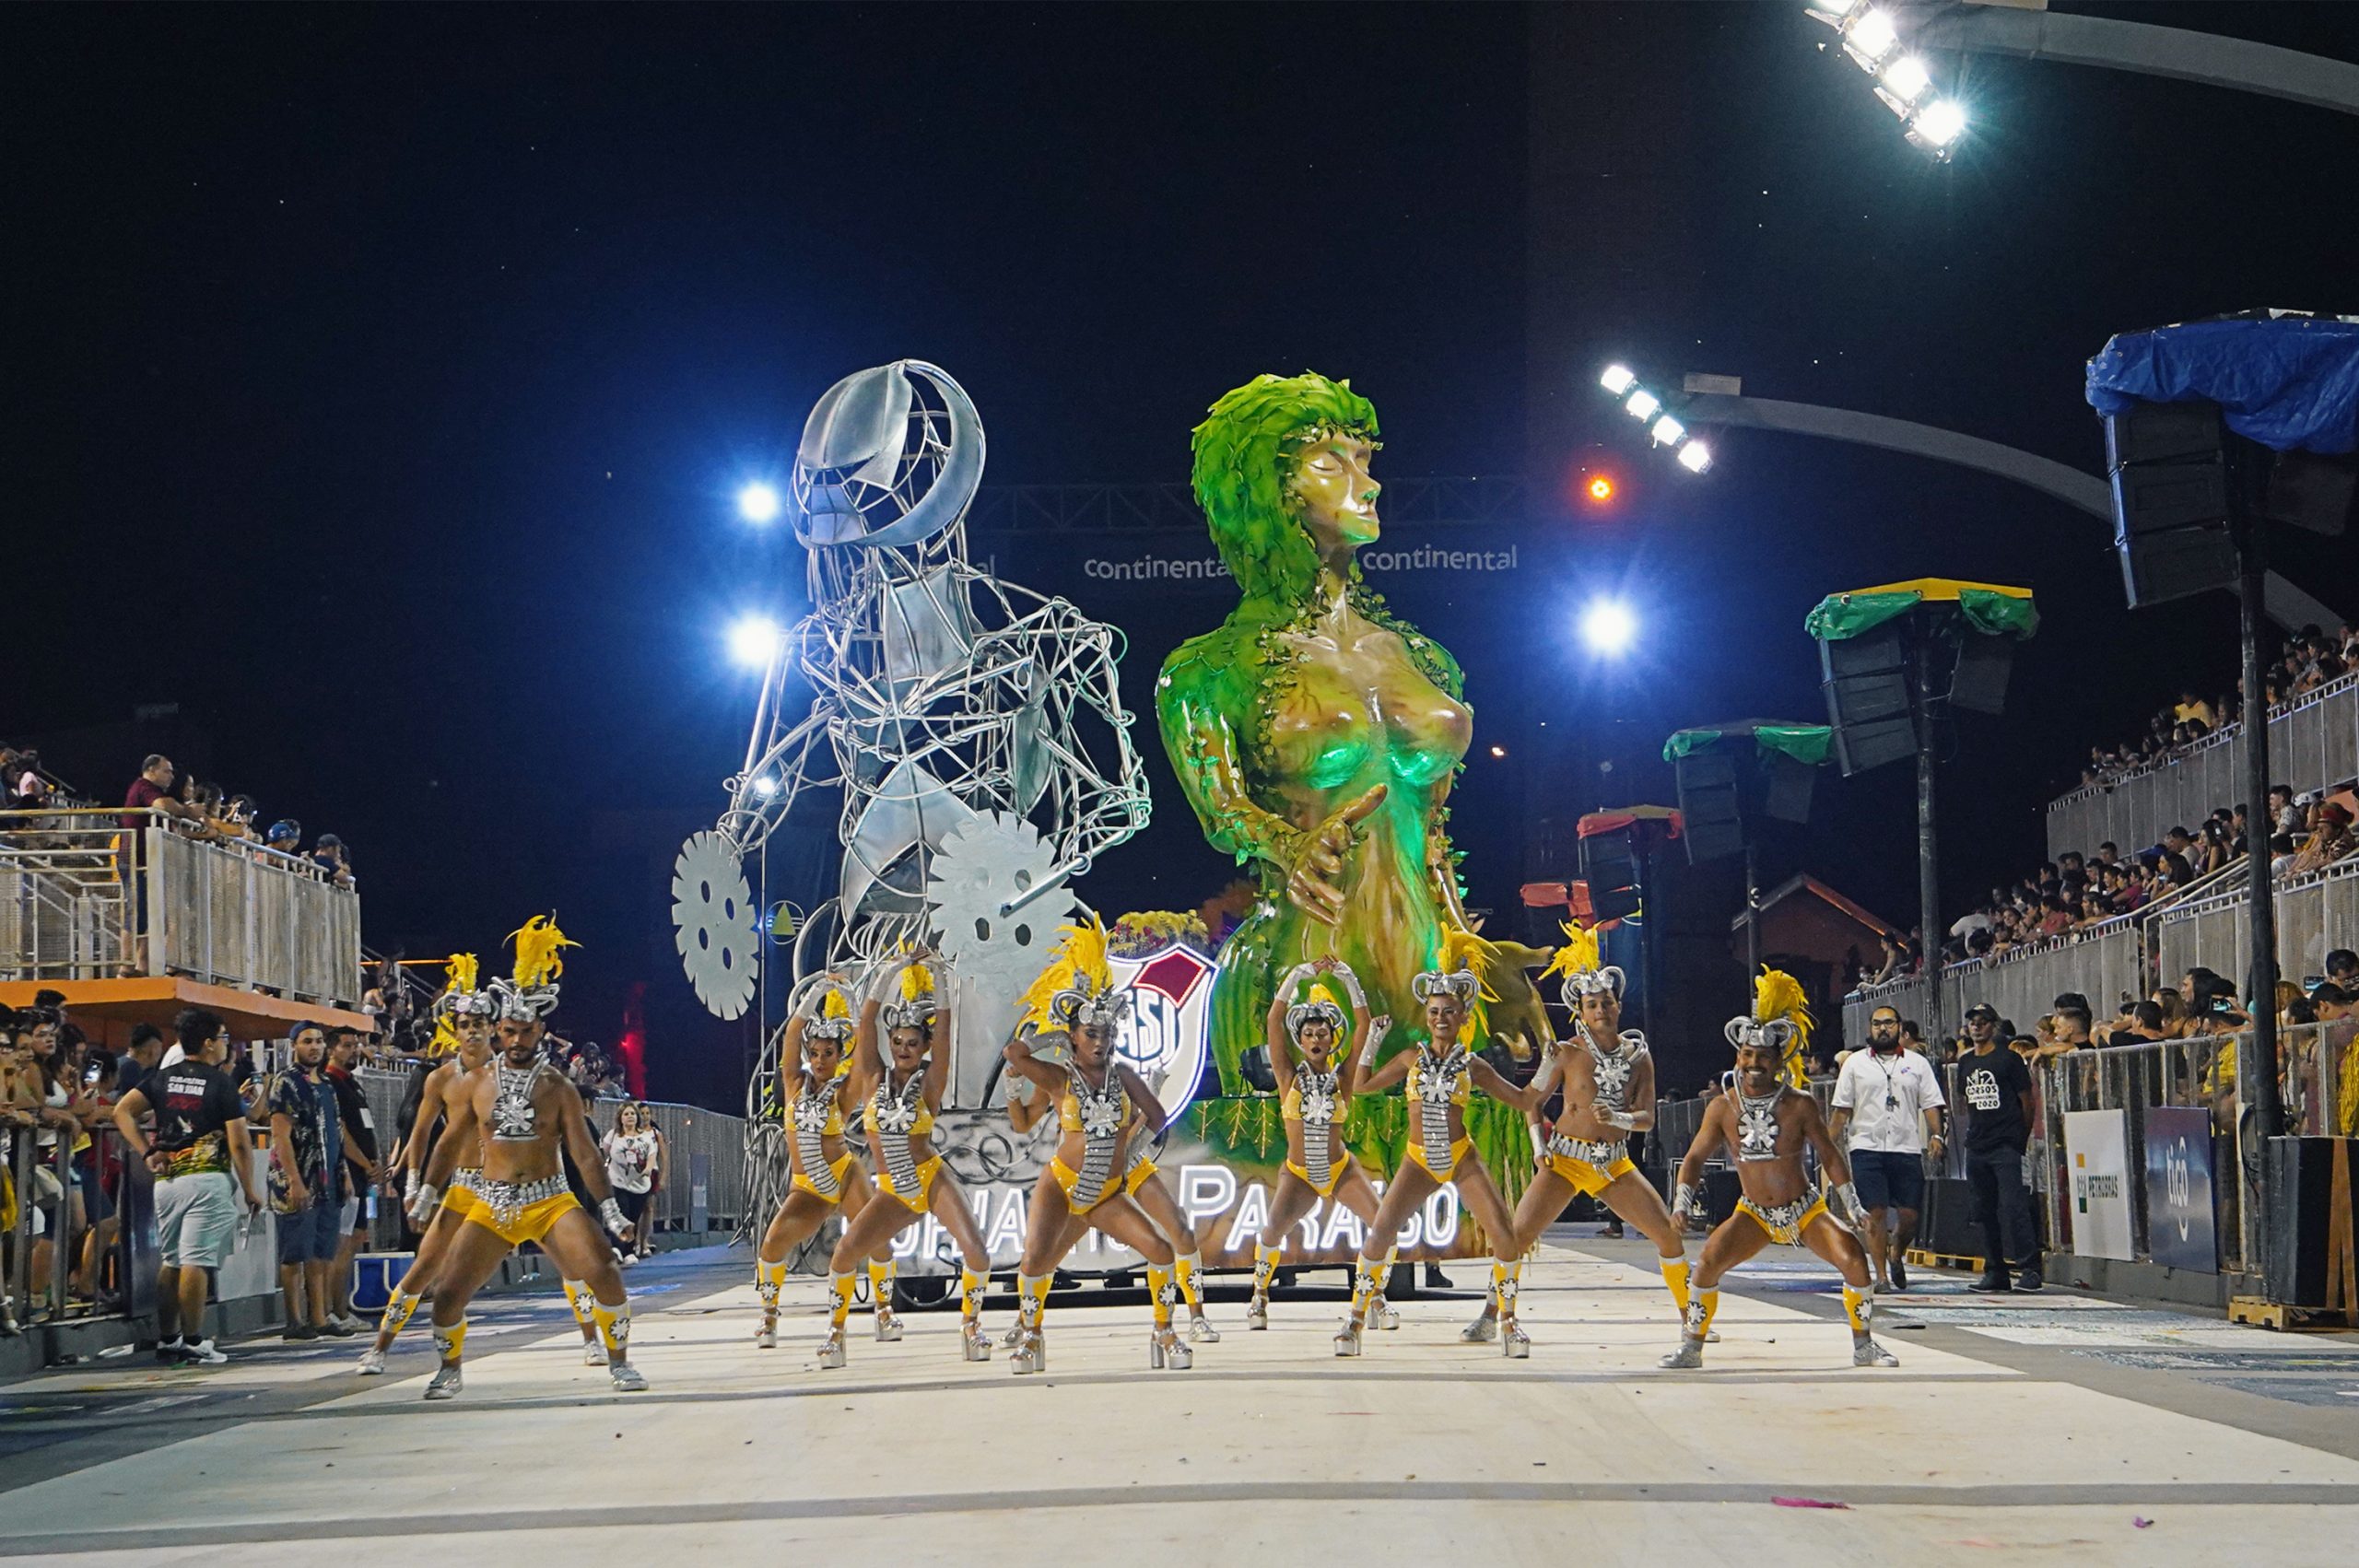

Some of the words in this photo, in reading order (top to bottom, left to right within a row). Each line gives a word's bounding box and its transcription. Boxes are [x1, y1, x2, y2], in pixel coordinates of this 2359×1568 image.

[1084, 554, 1232, 579] continenta
[1363, 544, 1517, 571] continental
[1966, 1085, 1998, 1095] CORSOS
[1978, 1099, 1999, 1108] 2020
[2088, 1175, 2118, 1199] PETROBRAS
[1179, 1164, 1460, 1251] PARAO
